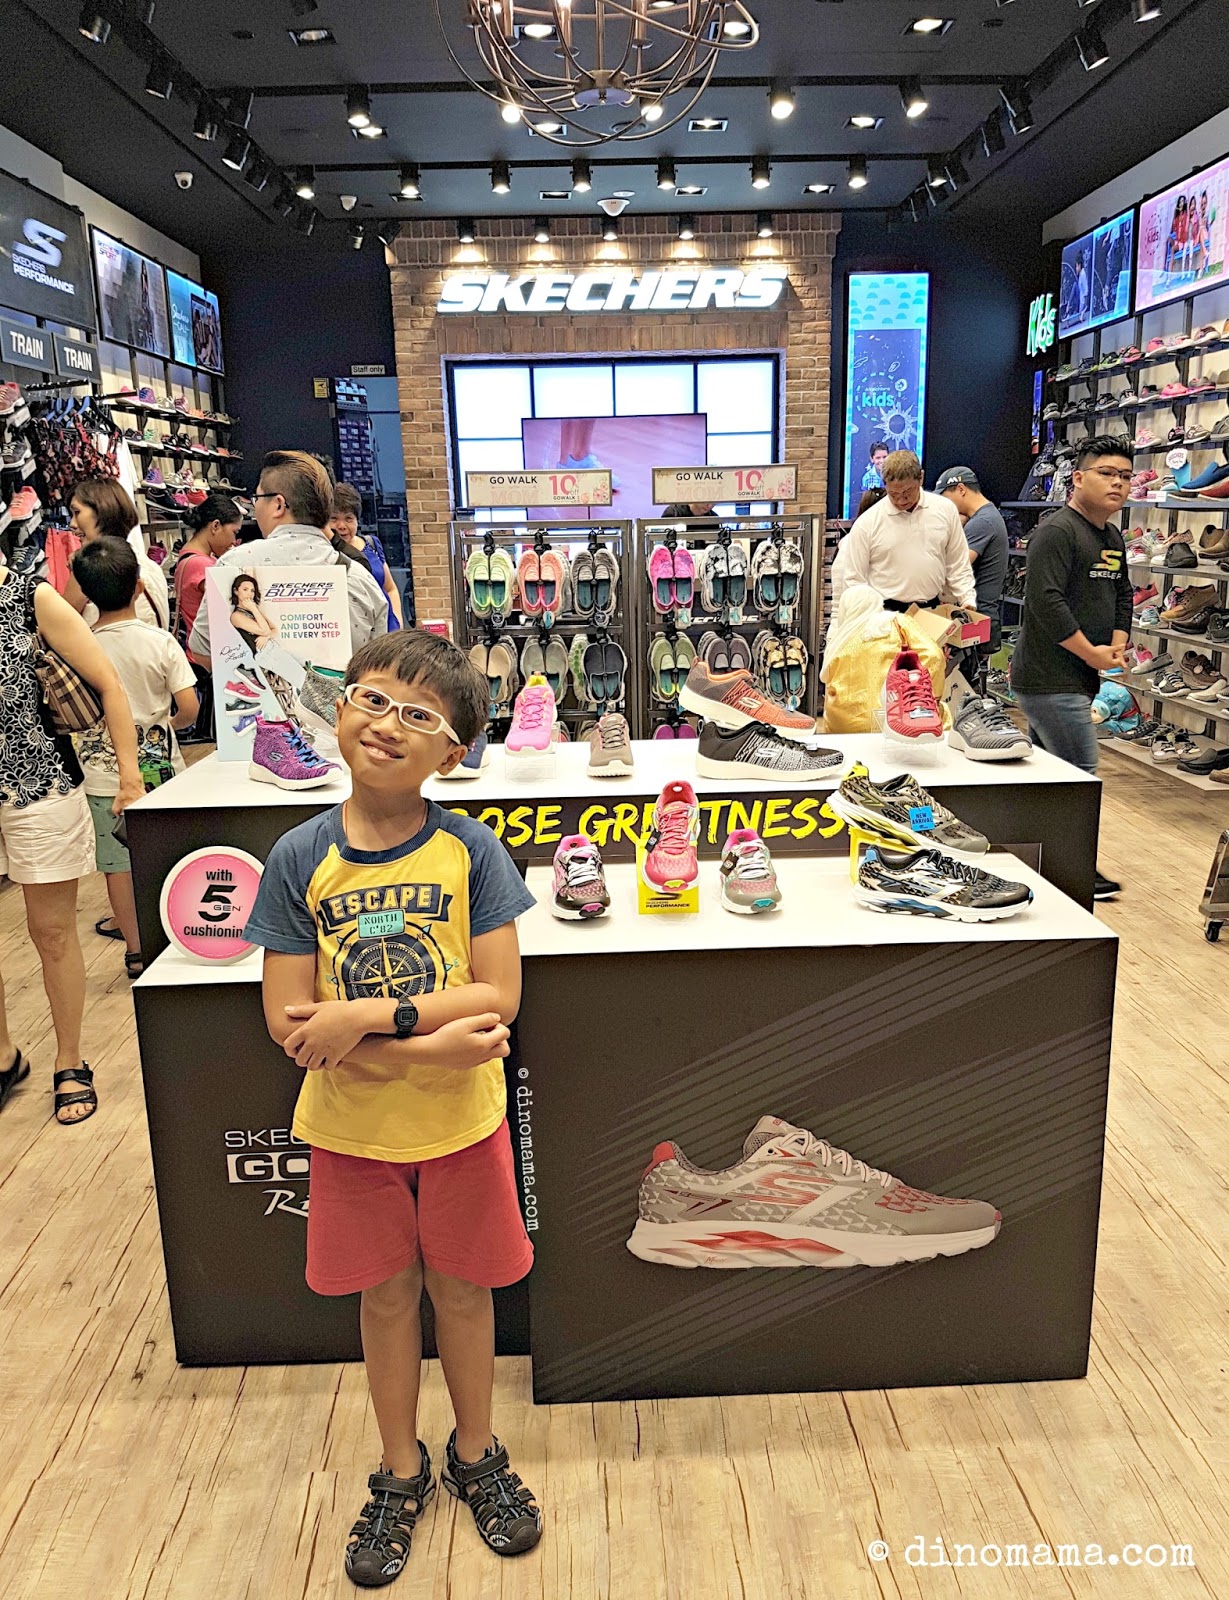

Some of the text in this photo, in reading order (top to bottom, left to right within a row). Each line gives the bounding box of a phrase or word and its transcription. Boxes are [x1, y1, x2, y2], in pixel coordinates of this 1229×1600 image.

[11, 253, 46, 274] SKECHERS
[12, 262, 76, 296] PERFORMANCE
[436, 268, 789, 313] SKECHERS
[1026, 292, 1058, 358] Kids
[9, 330, 44, 361] TRAIN
[63, 346, 93, 372] TRAIN
[370, 366, 384, 374] only
[862, 391, 895, 408] kids
[489, 476, 538, 485] GO WALK
[675, 471, 724, 481] GO WALK
[264, 588, 334, 598] BURST
[280, 613, 324, 621] COMFORT
[281, 622, 339, 631] AND BOUNCE
[293, 631, 319, 639] EVERY
[450, 803, 563, 848] OSE
[911, 817, 934, 825] ARRIVAL
[206, 868, 232, 881] with
[198, 884, 238, 923] 5
[328, 884, 433, 920] ESCAPE
[364, 912, 398, 925] NORTH
[416, 932, 428, 940] NE
